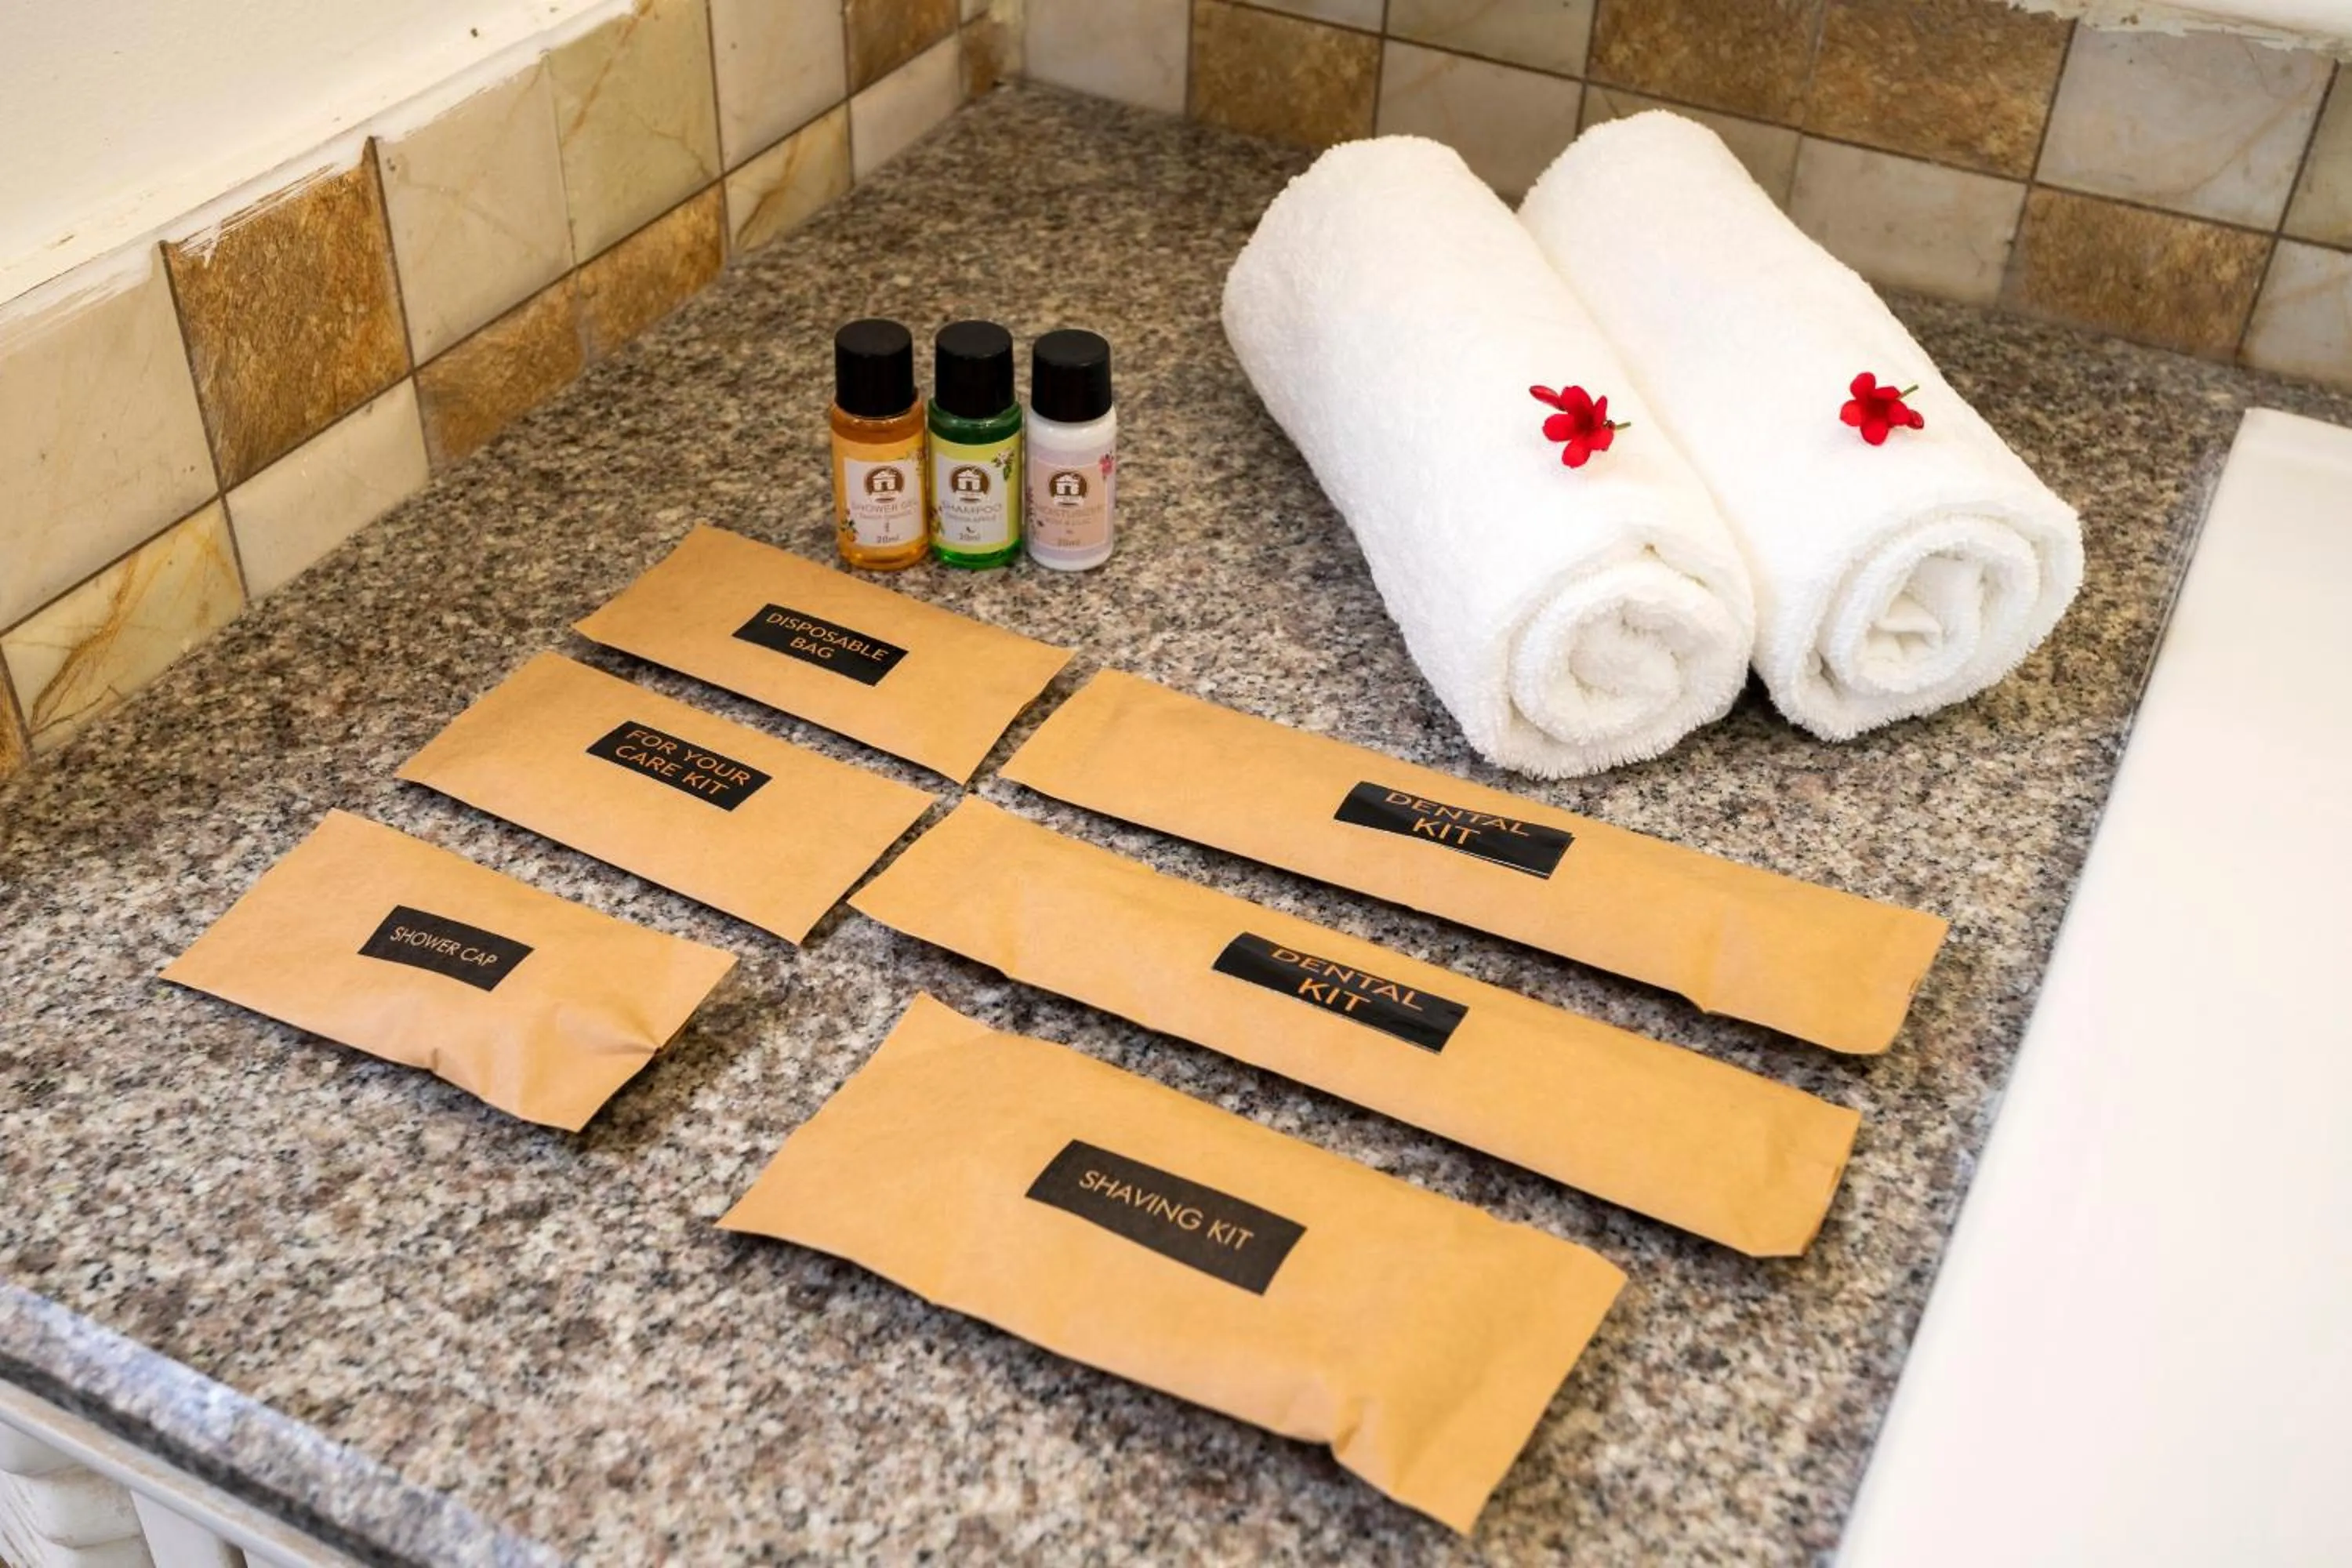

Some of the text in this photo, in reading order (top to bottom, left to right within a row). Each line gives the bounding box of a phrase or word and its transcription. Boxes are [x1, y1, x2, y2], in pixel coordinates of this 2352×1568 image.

[942, 501, 1002, 515] SHAMPOO
[877, 534, 900, 544] 20ml
[765, 612, 889, 662] DISPOSABLE
[789, 636, 835, 659] BAG
[615, 746, 729, 795] CARE KIT
[626, 730, 752, 786] FOR YOUR
[1385, 792, 1530, 837] DENTAL
[1412, 818, 1481, 845] KIT
[390, 926, 499, 967] SHOWER CAP
[1271, 948, 1424, 1011] DENTAL
[1298, 978, 1371, 1012] KIT
[1078, 1170, 1254, 1250] SHAVING KIT
